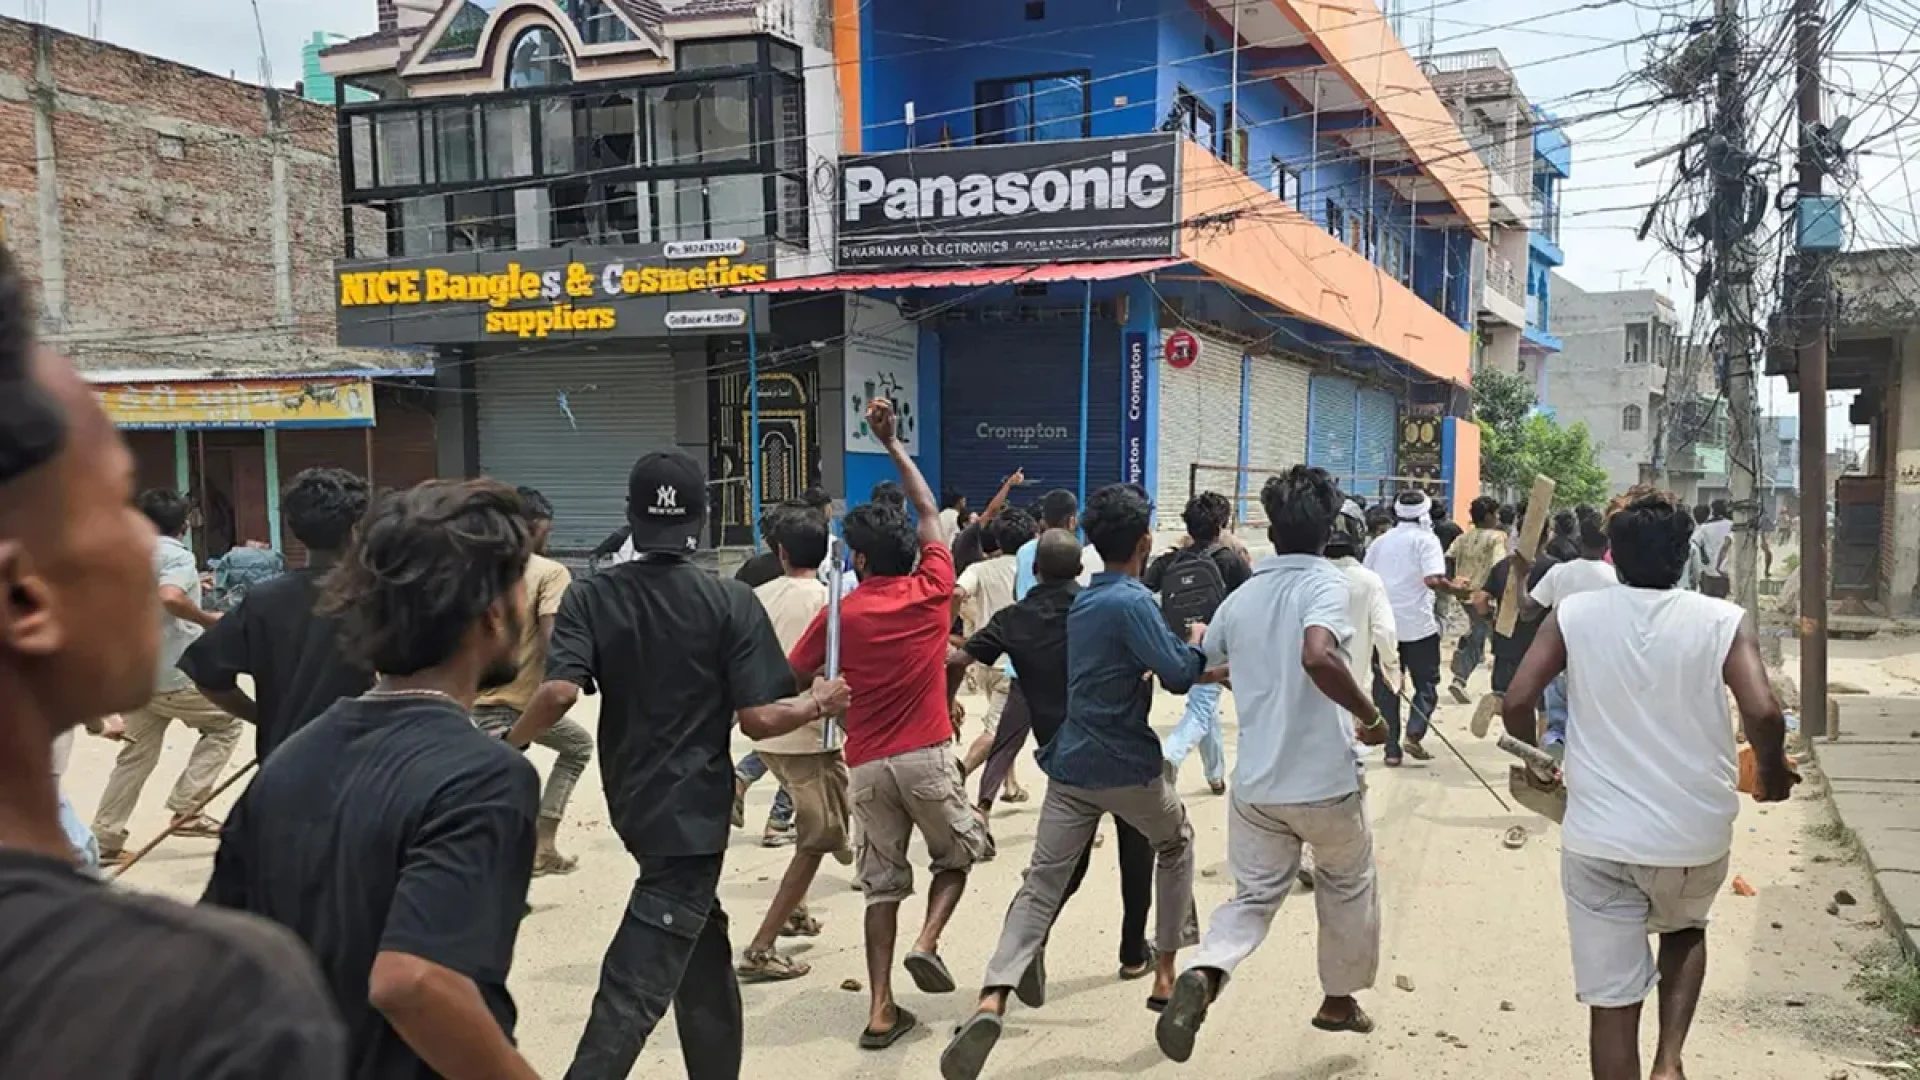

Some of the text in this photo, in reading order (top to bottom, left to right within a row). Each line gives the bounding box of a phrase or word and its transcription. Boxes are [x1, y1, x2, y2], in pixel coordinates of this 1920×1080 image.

[845, 151, 1167, 221] Panasonic
[842, 244, 919, 258] SWARNAKAR
[922, 241, 1009, 255] ELECTRONICS
[339, 257, 768, 308] NICE Bangles & Cosmetics
[486, 303, 617, 338] suppliers
[1128, 342, 1144, 420] Crompton
[976, 422, 1067, 443] Crompton
